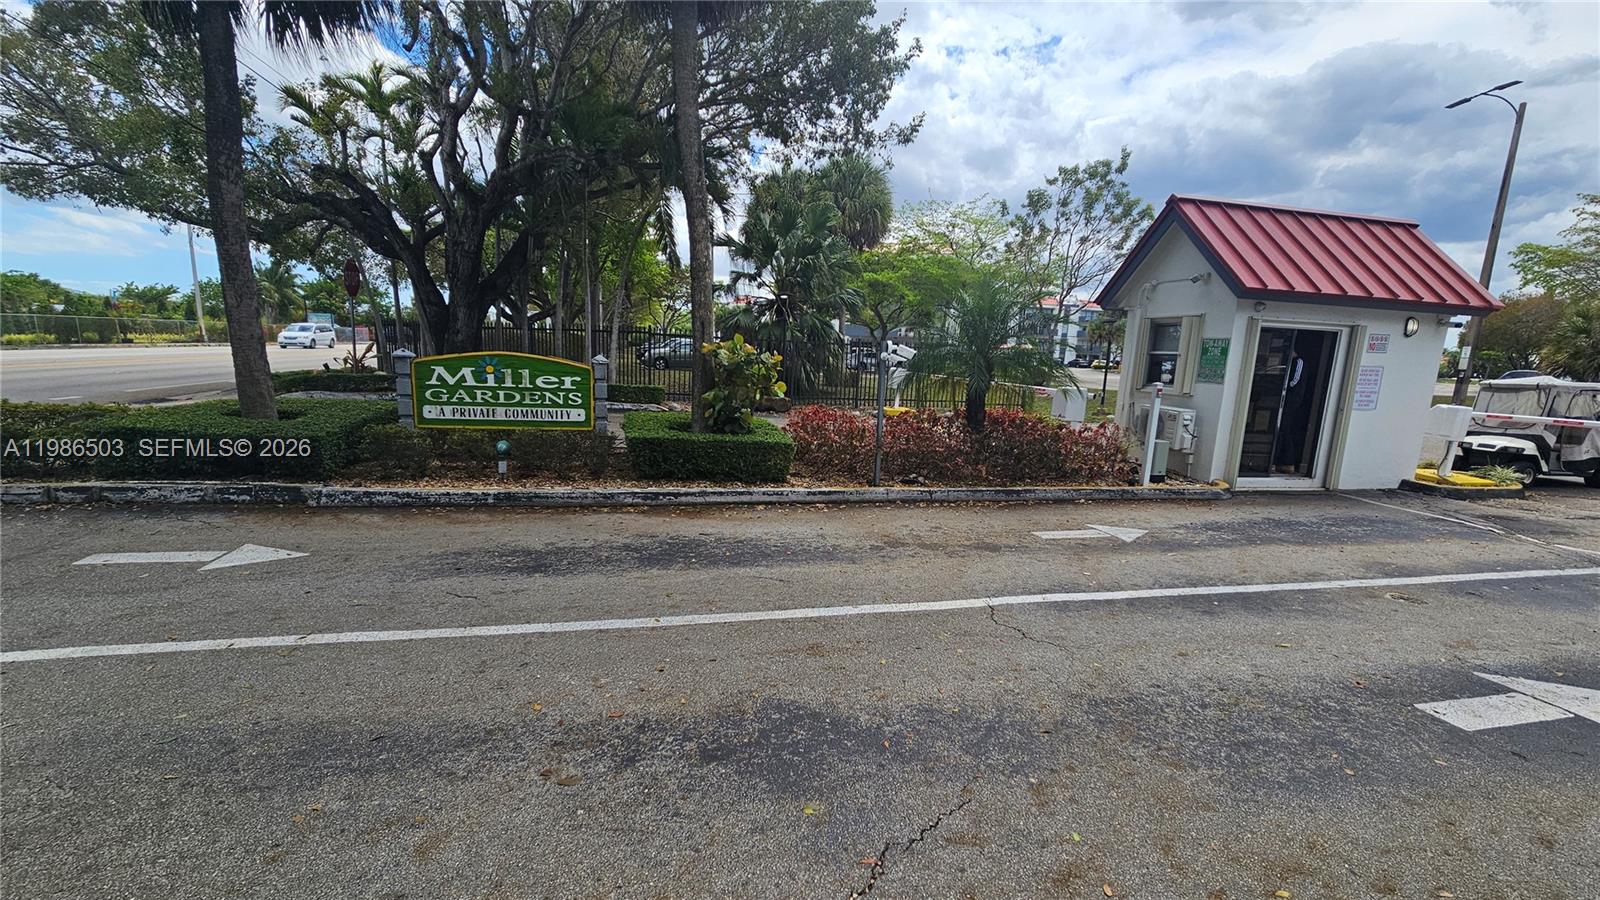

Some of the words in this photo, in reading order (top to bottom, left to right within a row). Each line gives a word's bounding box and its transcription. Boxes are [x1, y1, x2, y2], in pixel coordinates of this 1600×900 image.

[425, 365, 582, 389] Miller
[424, 388, 583, 405] GARDENS
[438, 406, 446, 418] A
[452, 407, 497, 419] PRIVATE
[504, 408, 573, 421] COMMUNITY
